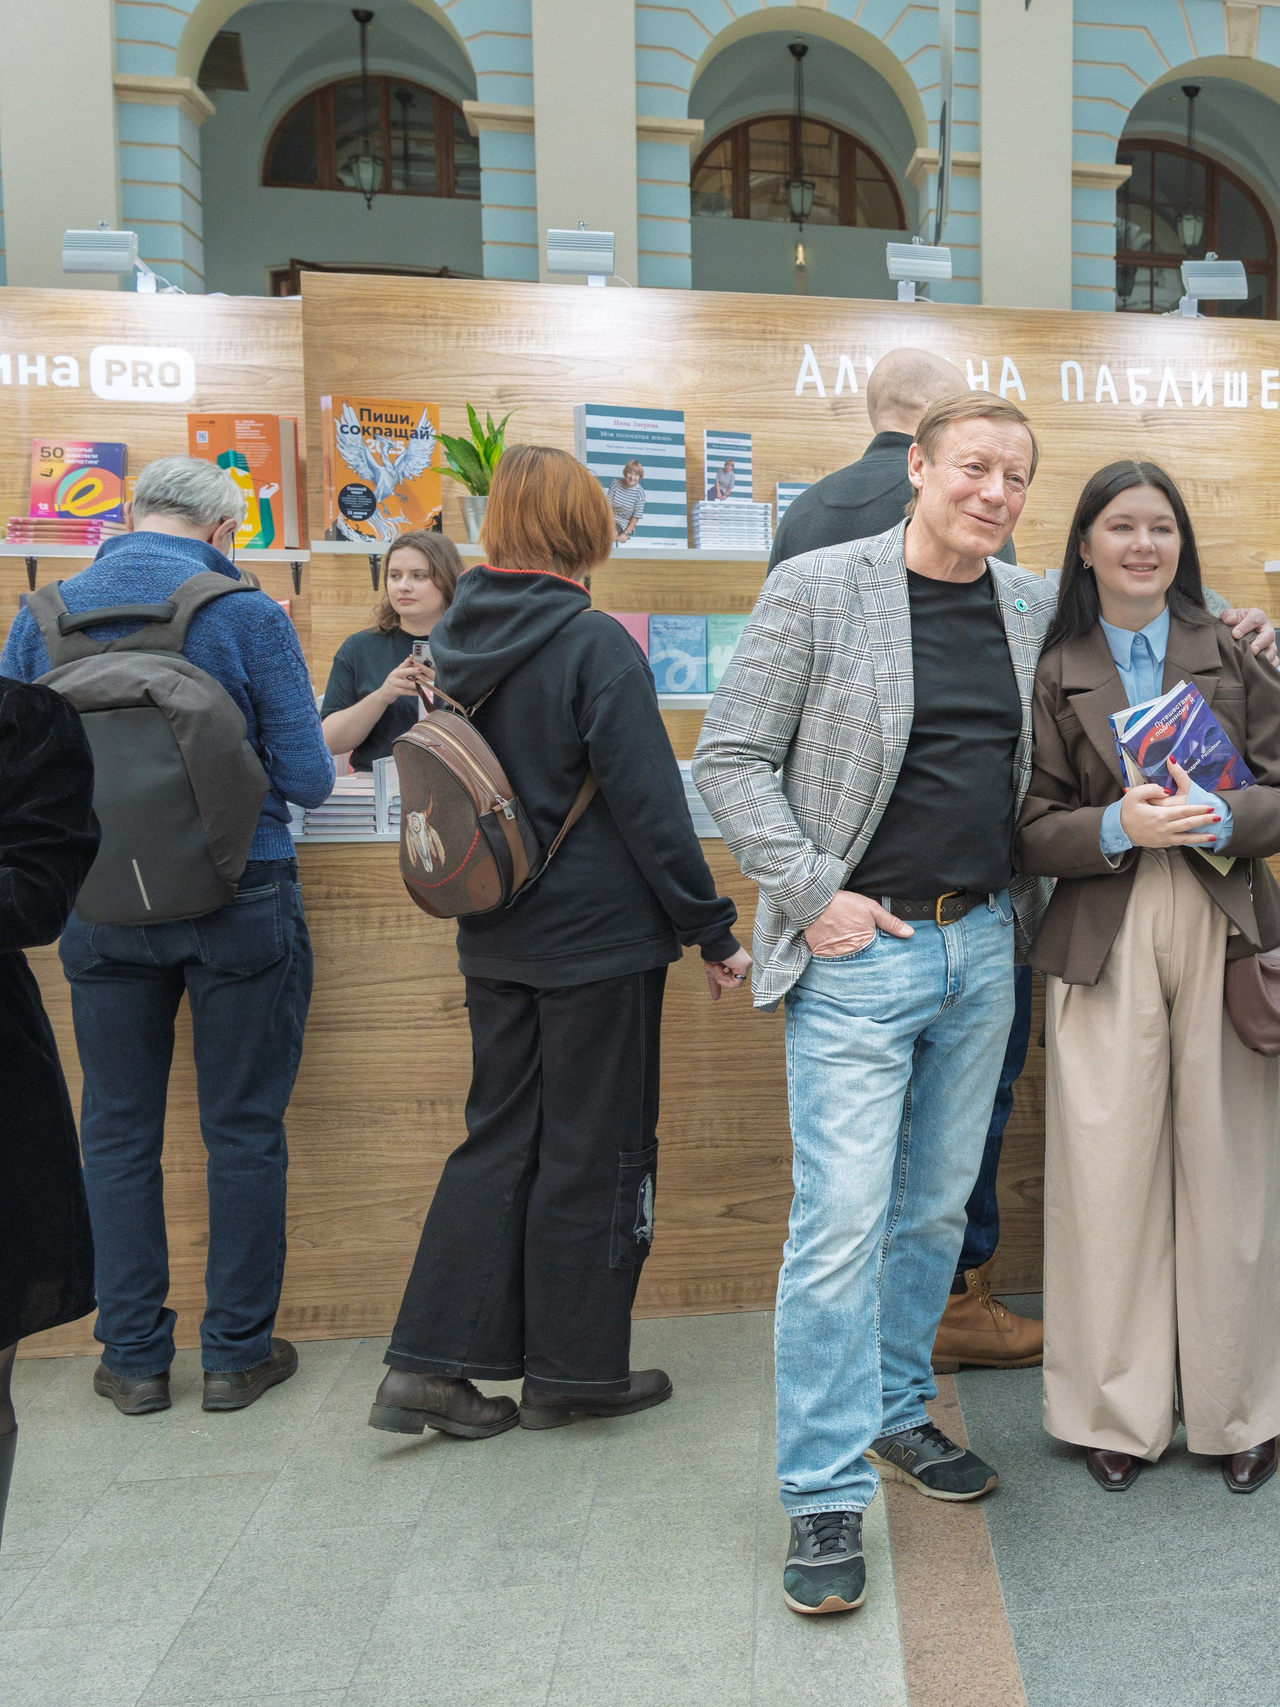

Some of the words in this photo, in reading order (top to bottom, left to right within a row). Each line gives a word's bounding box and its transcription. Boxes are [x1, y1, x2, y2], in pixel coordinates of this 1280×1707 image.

[105, 359, 182, 388] PRO
[795, 343, 1027, 401] АЛНА
[360, 408, 415, 426] Пиши,
[340, 424, 430, 440] сокращай
[615, 432, 649, 440] полосатая
[40, 446, 65, 459] 50
[1154, 693, 1192, 728] Путешествие
[1155, 703, 1190, 738] подлинному
